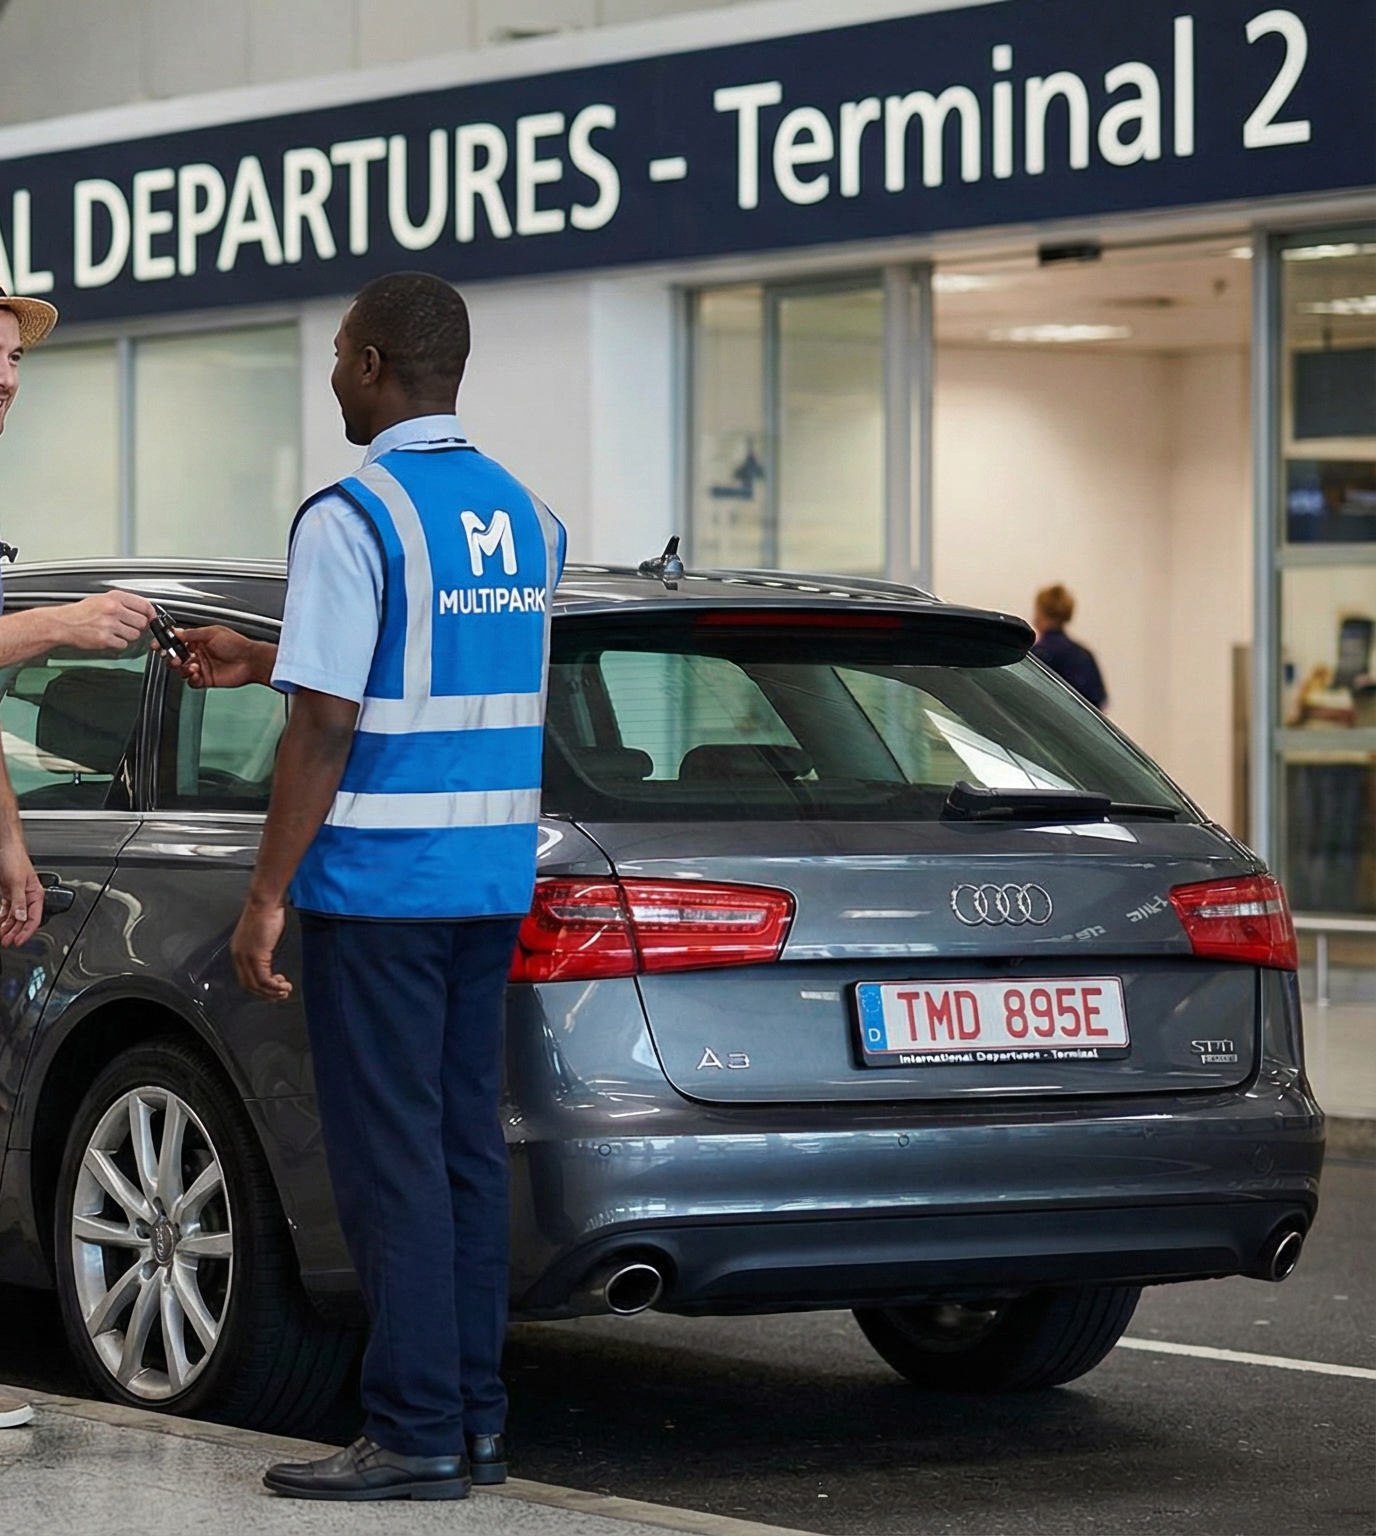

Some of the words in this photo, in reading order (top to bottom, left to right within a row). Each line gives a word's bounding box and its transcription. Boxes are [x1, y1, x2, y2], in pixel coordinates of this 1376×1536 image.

[73, 103, 621, 290] DEPARTURES
[649, 156, 688, 183] -
[714, 14, 1195, 211] Terminal
[1243, 8, 1312, 149] 2
[439, 586, 546, 615] MULTIPARK
[896, 989, 981, 1042] TMD
[1003, 986, 1109, 1039] 895E
[868, 1027, 881, 1042] D
[696, 1046, 750, 1070] A3
